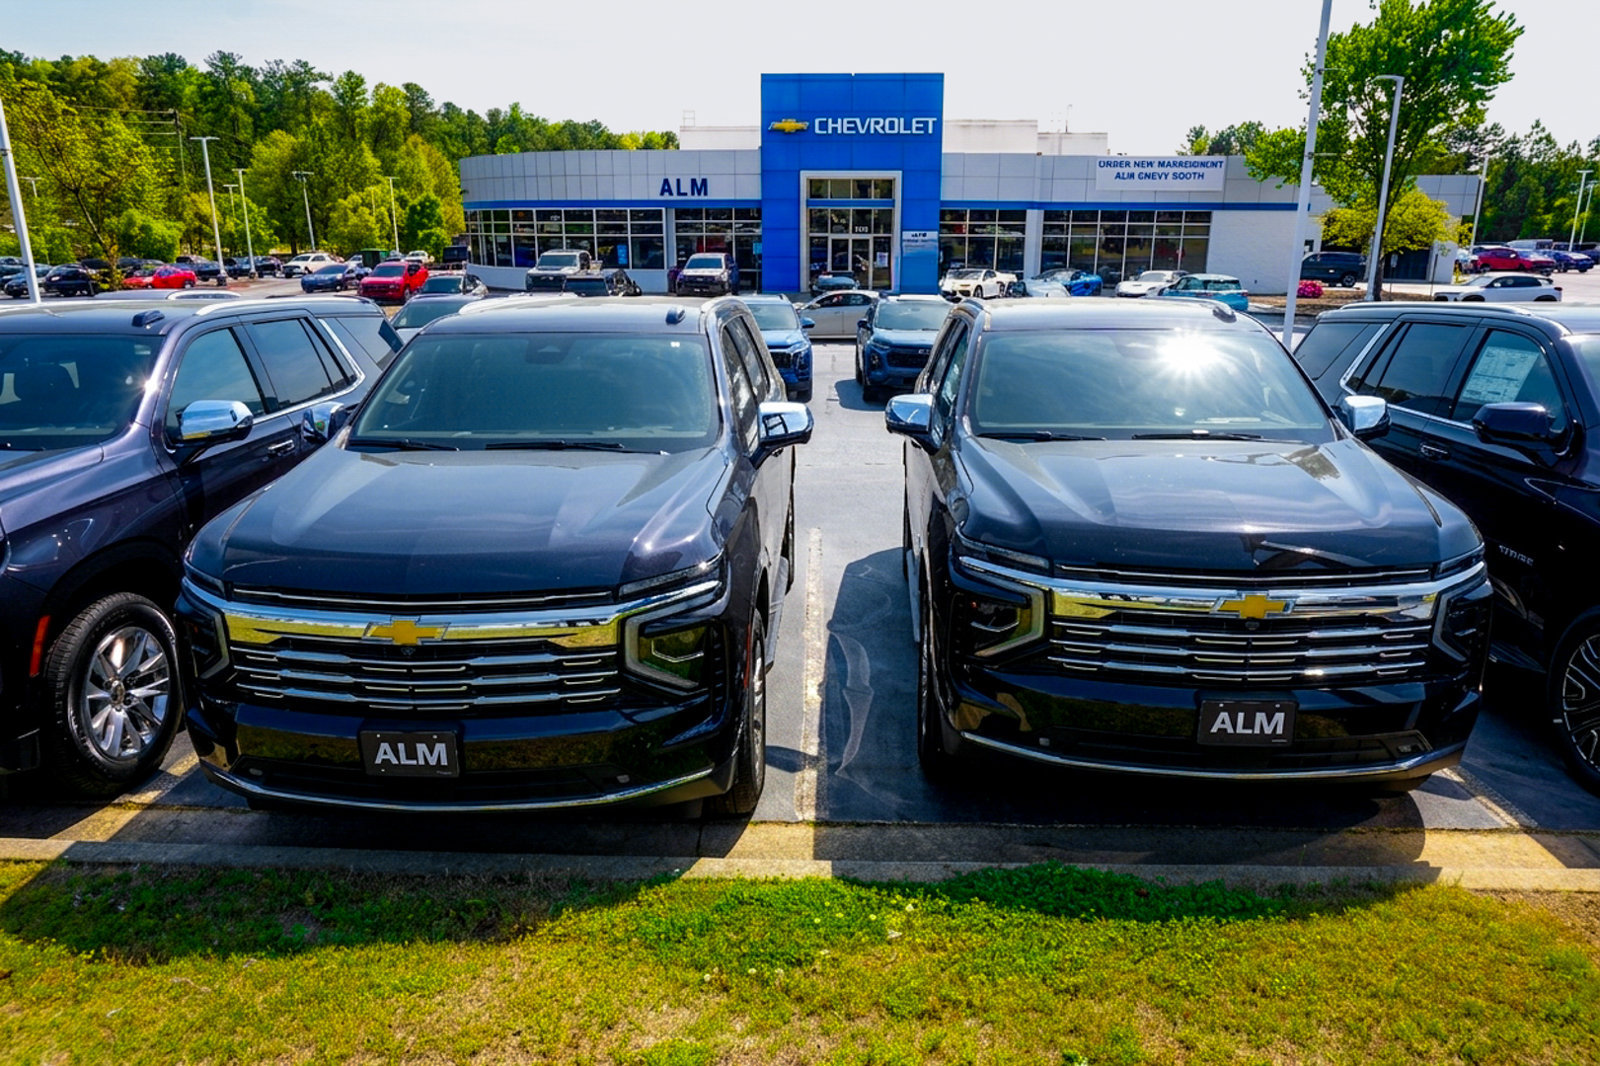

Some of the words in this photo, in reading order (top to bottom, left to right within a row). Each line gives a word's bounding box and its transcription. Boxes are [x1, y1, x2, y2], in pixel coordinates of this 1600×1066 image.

[814, 117, 937, 135] CHEVROLET
[1134, 160, 1156, 169] NEW
[660, 178, 708, 197] ALM
[1209, 711, 1285, 735] ALM
[374, 742, 448, 766] ALM
